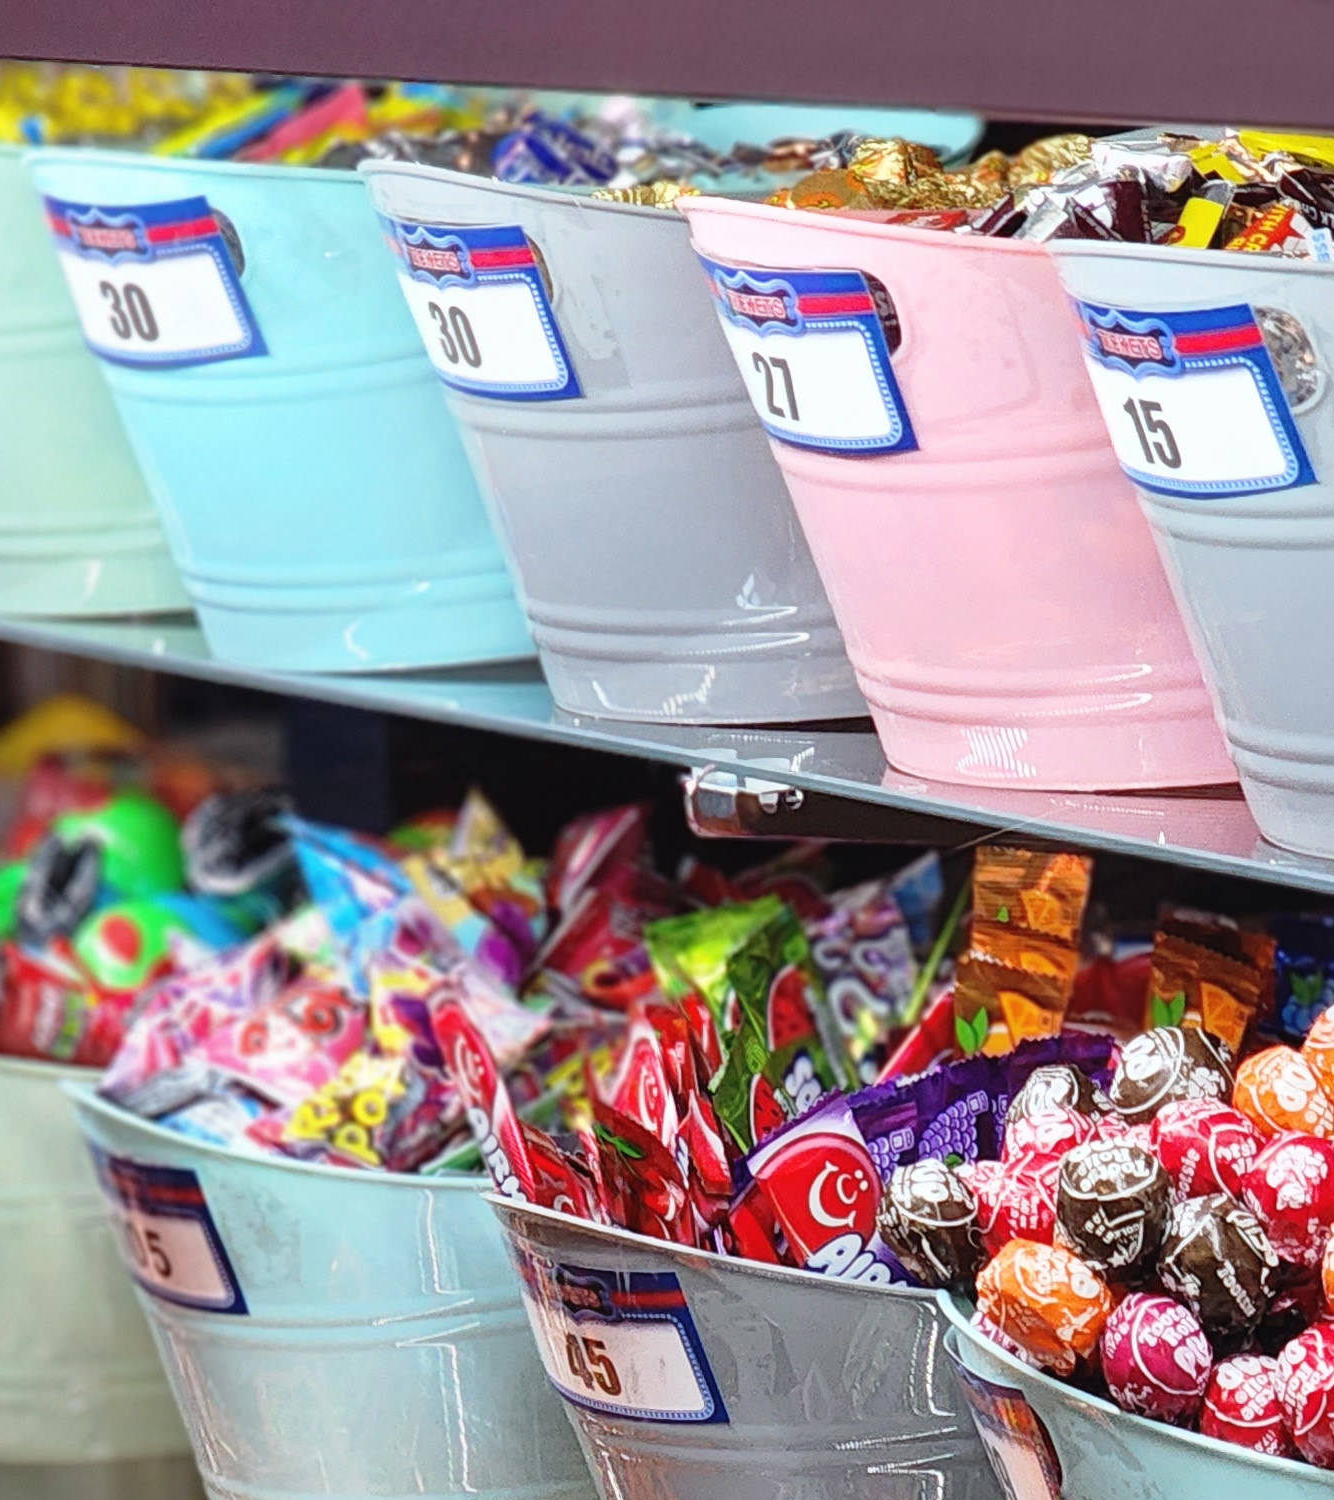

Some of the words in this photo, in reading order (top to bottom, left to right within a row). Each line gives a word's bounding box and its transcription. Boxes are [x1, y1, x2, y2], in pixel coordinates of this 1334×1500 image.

[99, 278, 160, 342] 30
[428, 301, 483, 368] 30
[751, 352, 800, 422] 27
[1123, 396, 1182, 470] 15
[566, 1333, 623, 1397] 45
